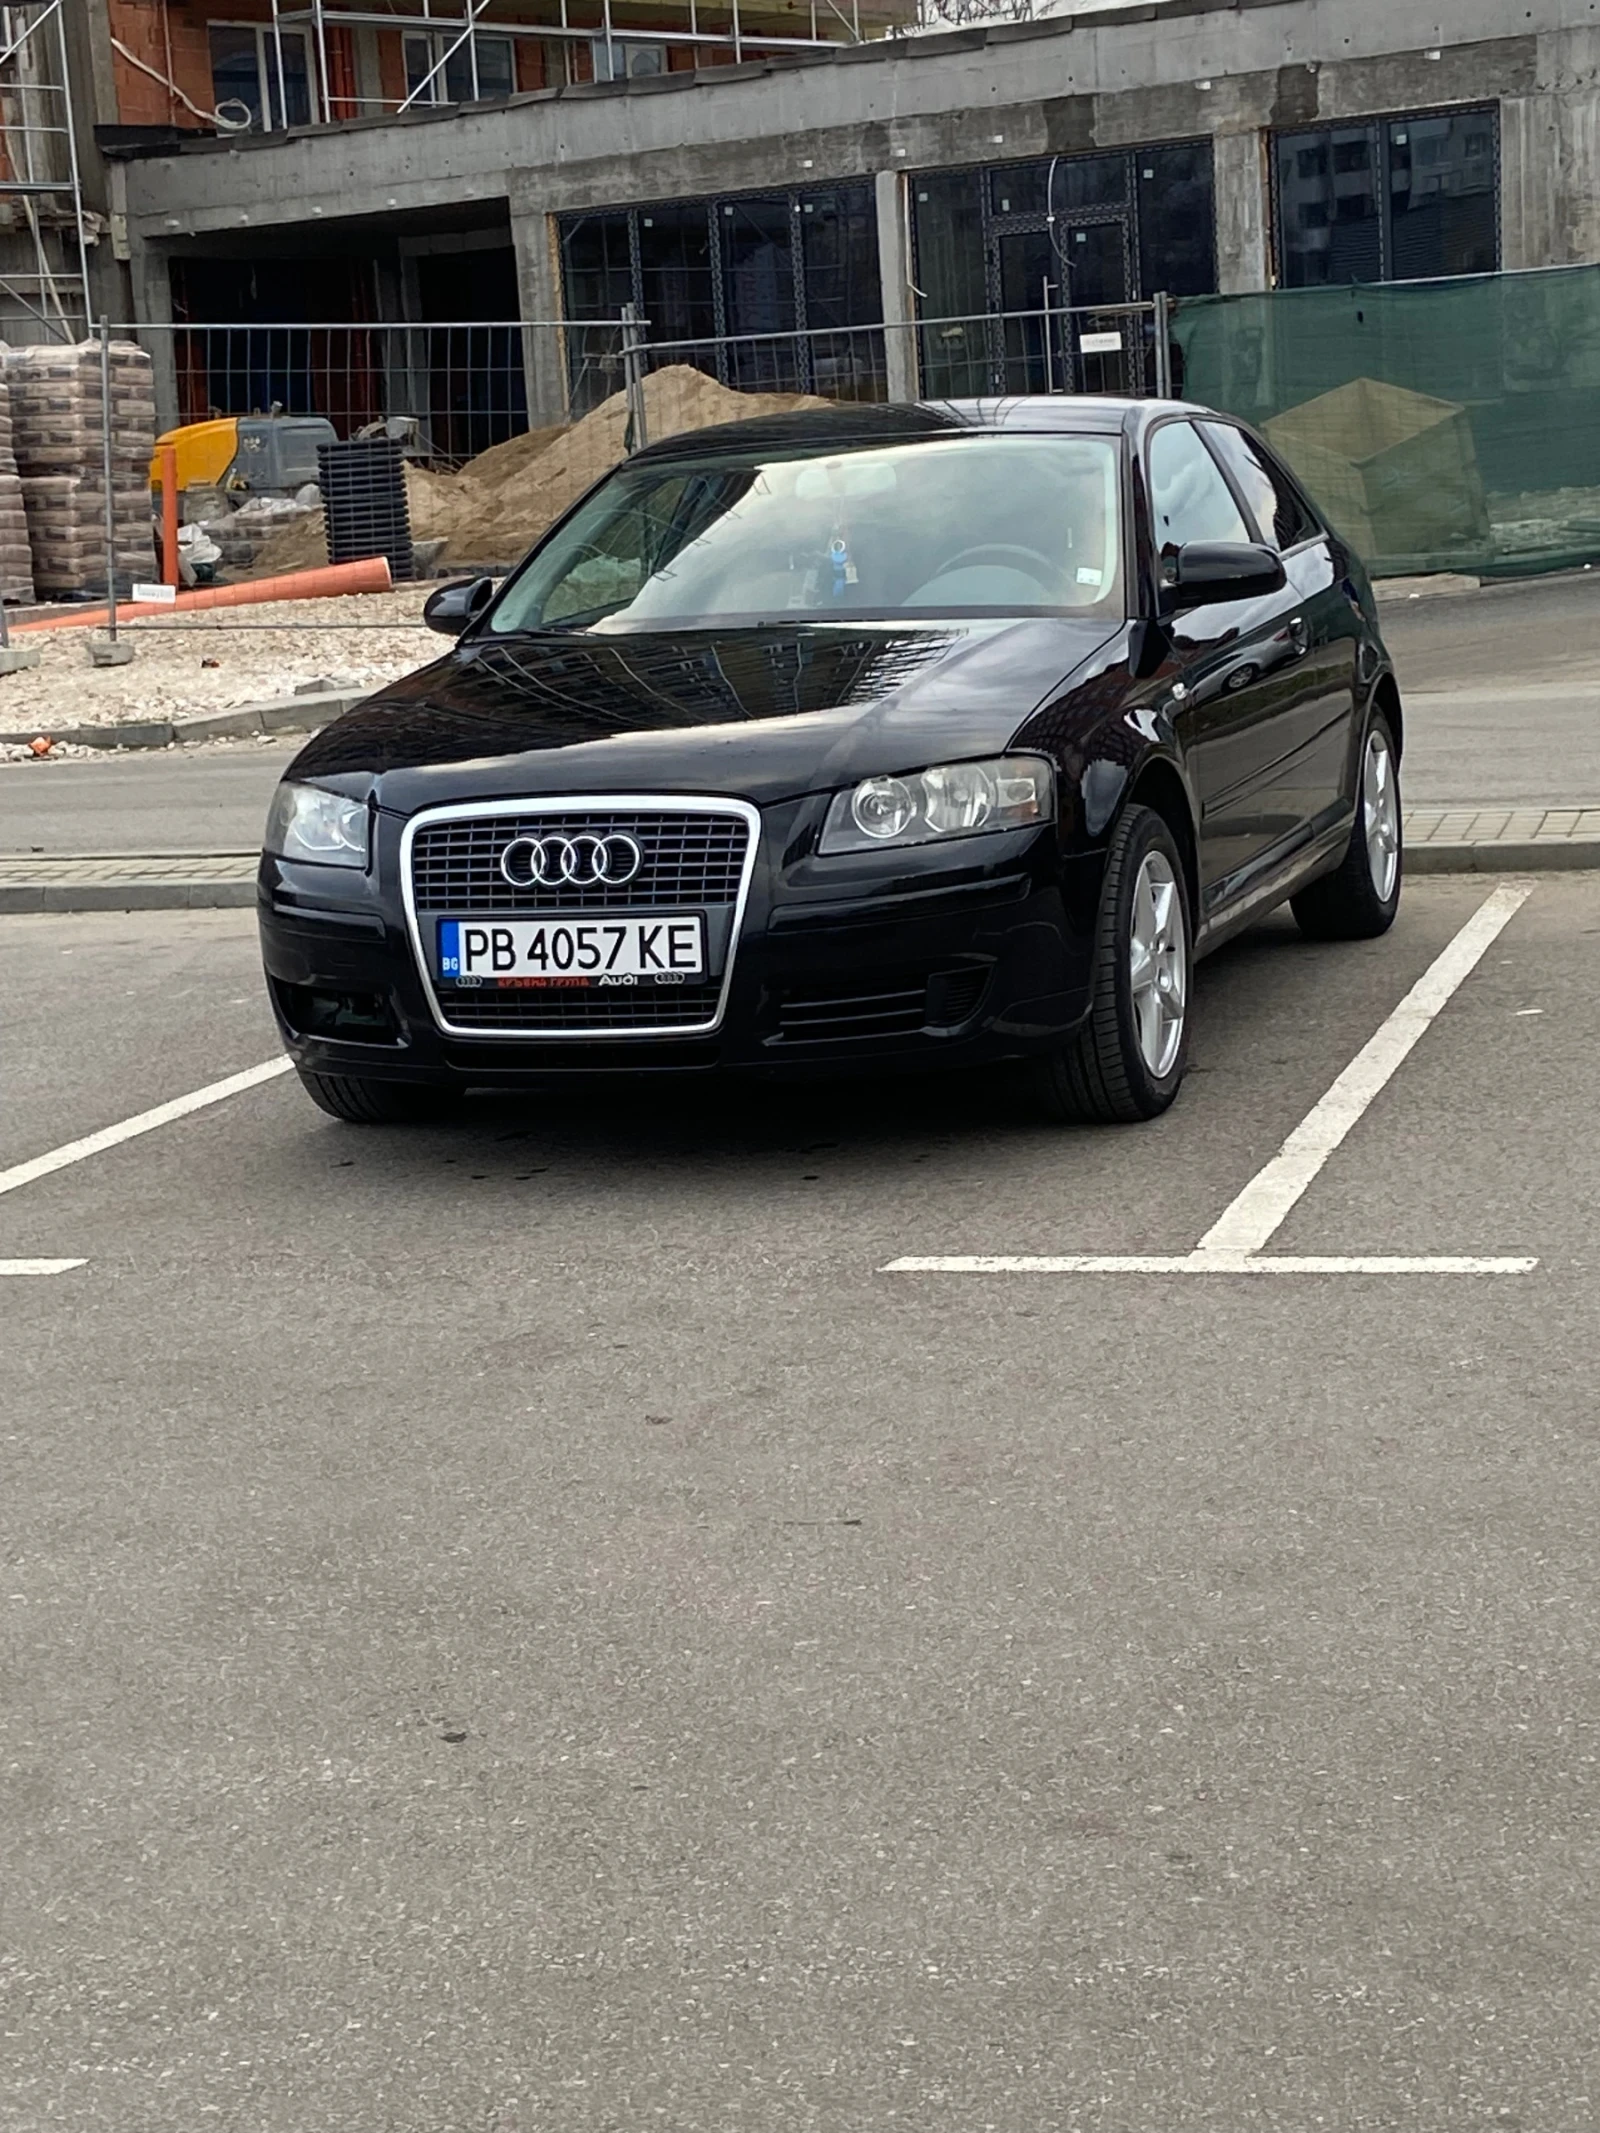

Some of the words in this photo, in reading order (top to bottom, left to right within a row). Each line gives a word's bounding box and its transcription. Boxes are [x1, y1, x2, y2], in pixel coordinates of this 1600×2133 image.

[464, 929, 516, 971] PB
[527, 927, 627, 970] 4057
[639, 925, 697, 969] KE
[442, 957, 458, 971] BG
[598, 974, 639, 986] Audi
